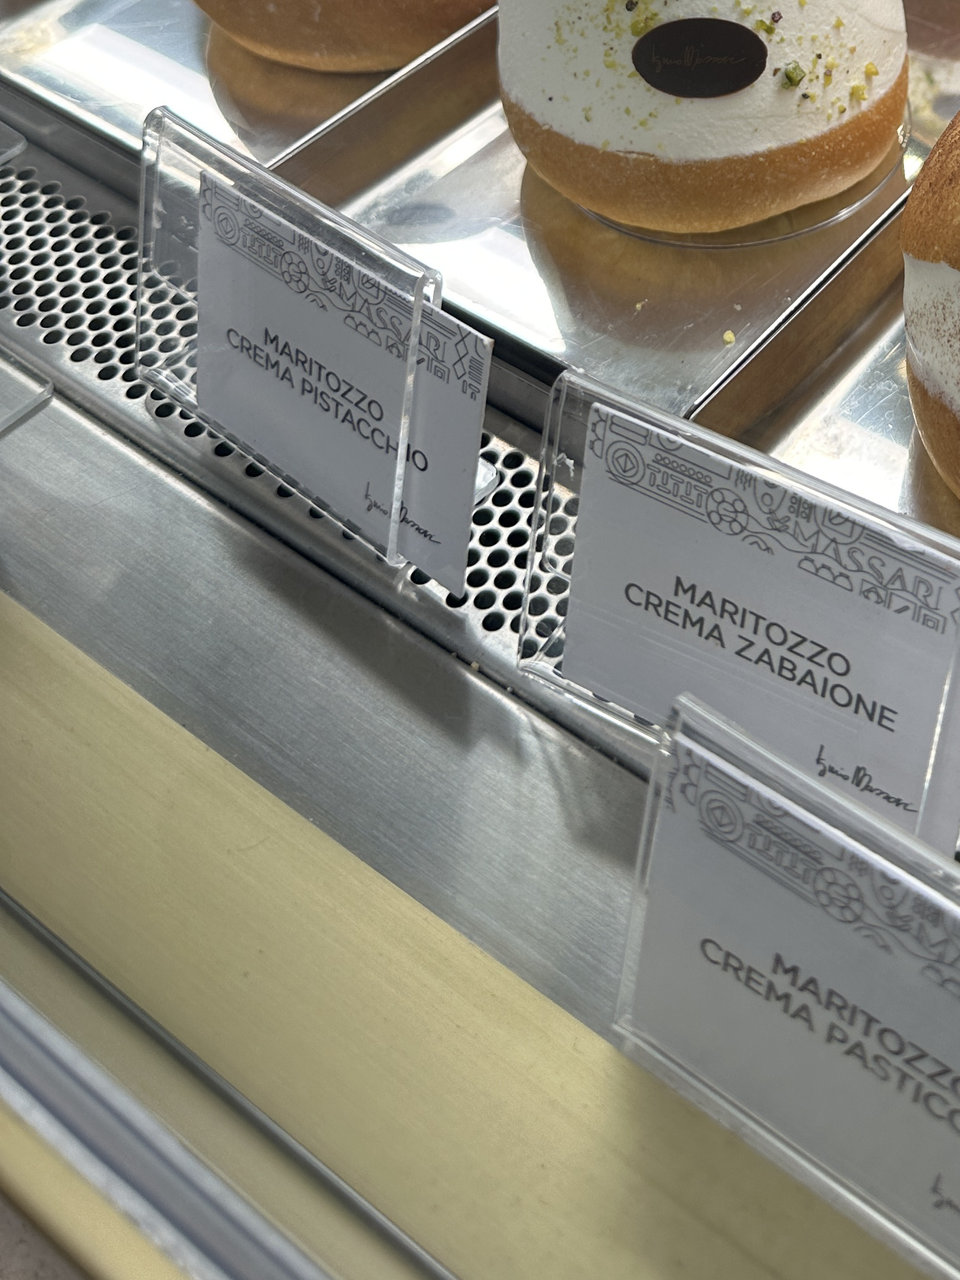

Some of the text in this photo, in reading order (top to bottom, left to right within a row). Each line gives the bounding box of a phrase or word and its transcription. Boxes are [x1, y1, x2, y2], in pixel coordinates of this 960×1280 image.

[226, 327, 429, 472] CREMA PISTACCHIO
[264, 326, 384, 421] MARITOZZO
[793, 520, 943, 610] MASSARI
[624, 582, 899, 733] CREMA ZABAIONE
[673, 575, 851, 677] MARITOZZO
[700, 937, 816, 1033] CREMA
